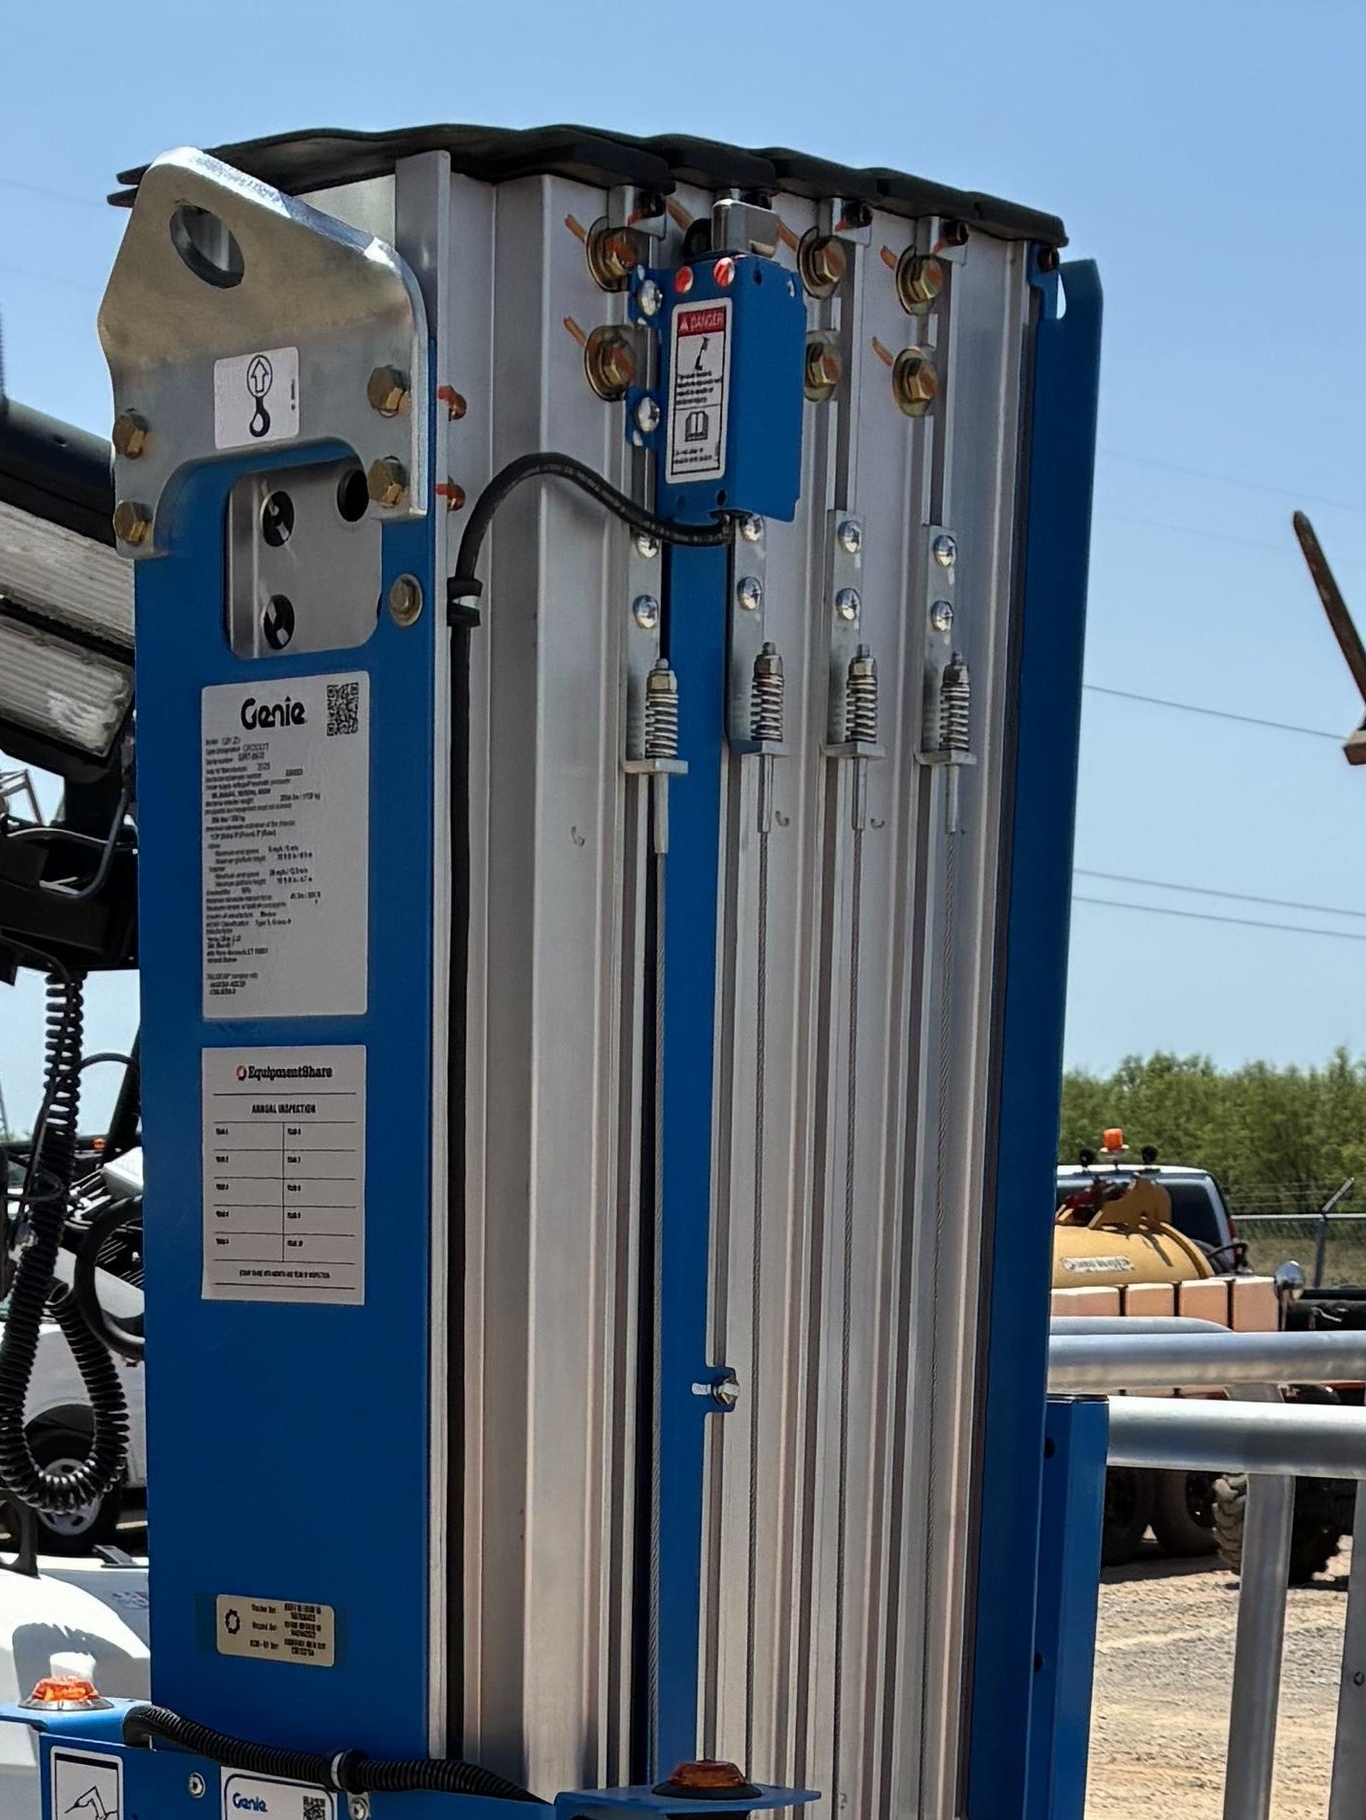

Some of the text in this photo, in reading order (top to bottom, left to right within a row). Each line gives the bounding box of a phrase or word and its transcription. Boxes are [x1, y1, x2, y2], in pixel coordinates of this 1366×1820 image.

[689, 313, 724, 332] DANGER
[241, 696, 306, 731] Genie
[248, 1066, 333, 1081] EquipmentShare
[278, 1104, 317, 1114] INSPECTION
[232, 1792, 269, 1813] Genie
